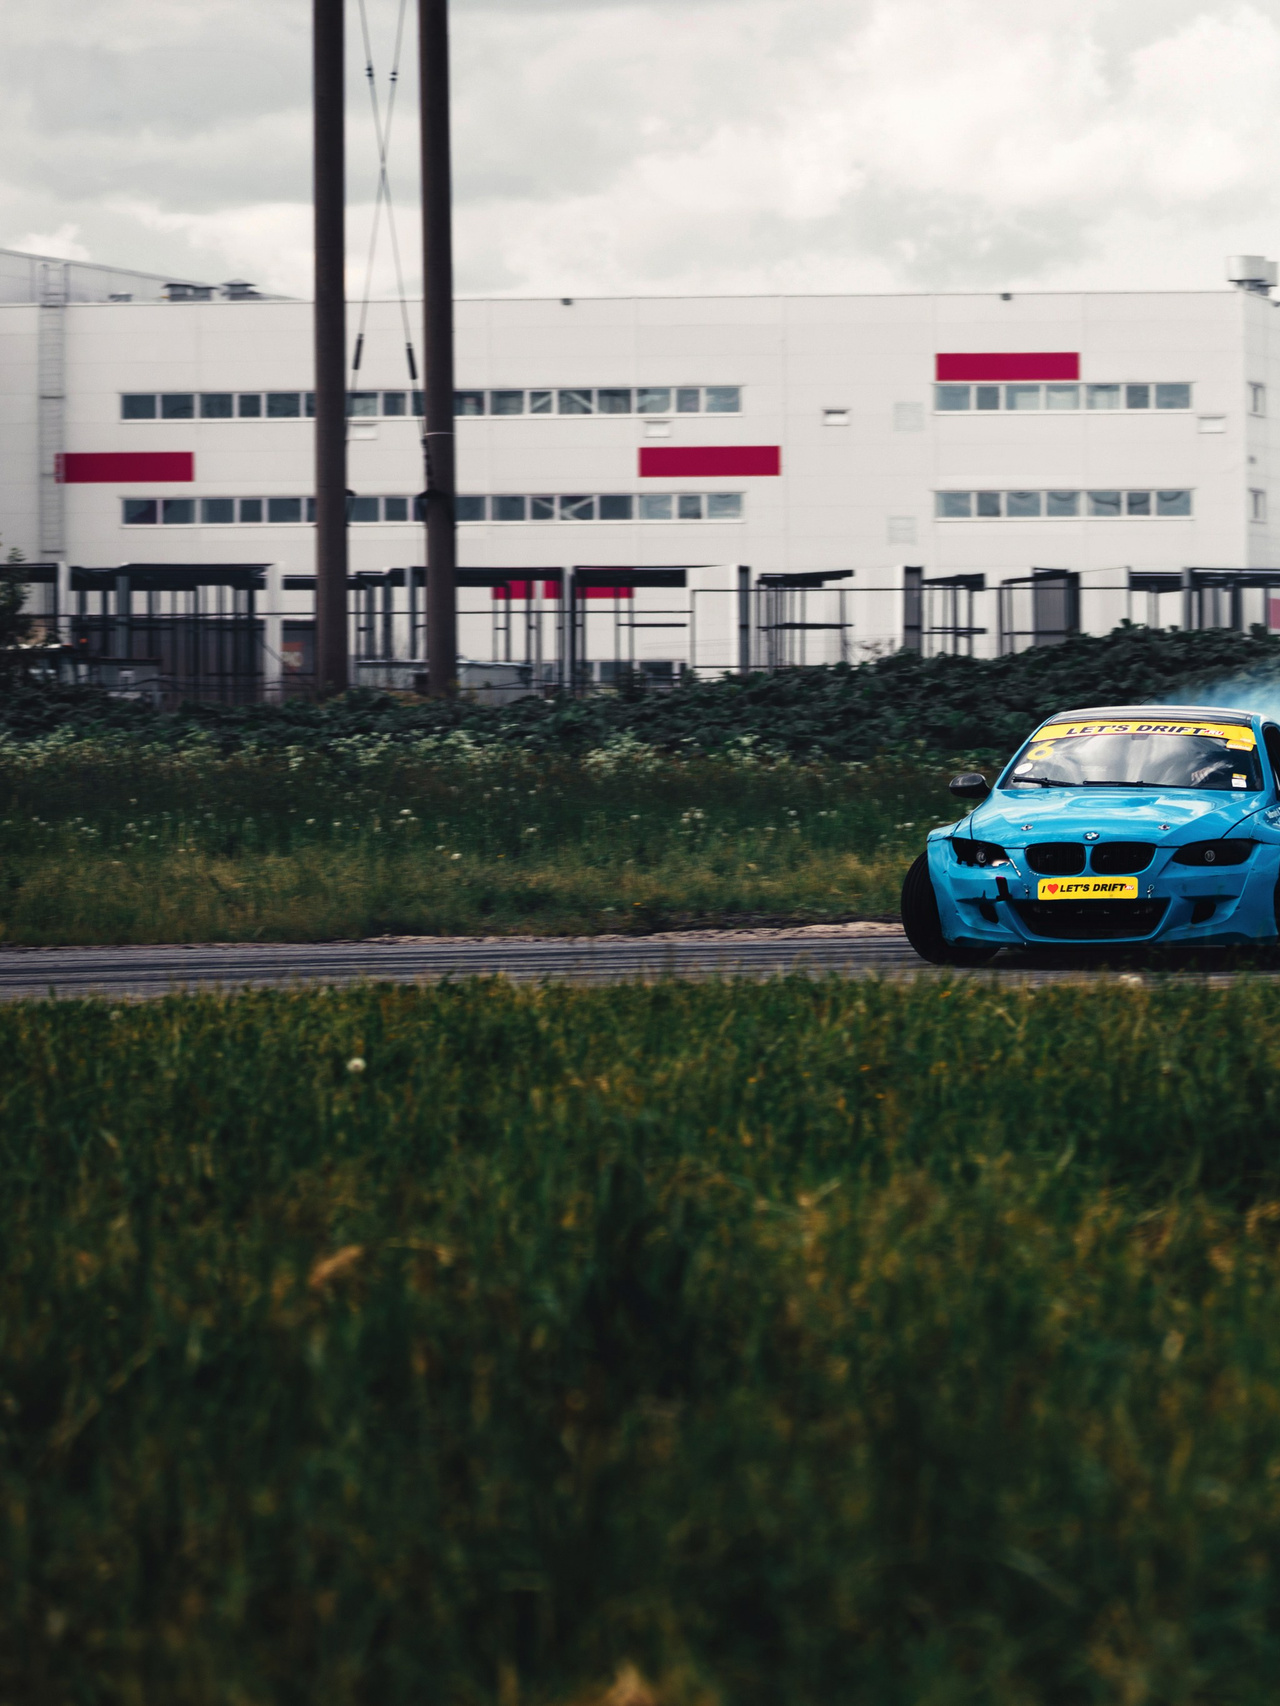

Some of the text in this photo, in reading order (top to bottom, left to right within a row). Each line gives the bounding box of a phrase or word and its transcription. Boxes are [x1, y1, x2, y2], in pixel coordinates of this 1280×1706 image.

[1066, 725, 1129, 735] LET'S
[1027, 740, 1055, 760] 6
[1060, 884, 1090, 892] LET'S
